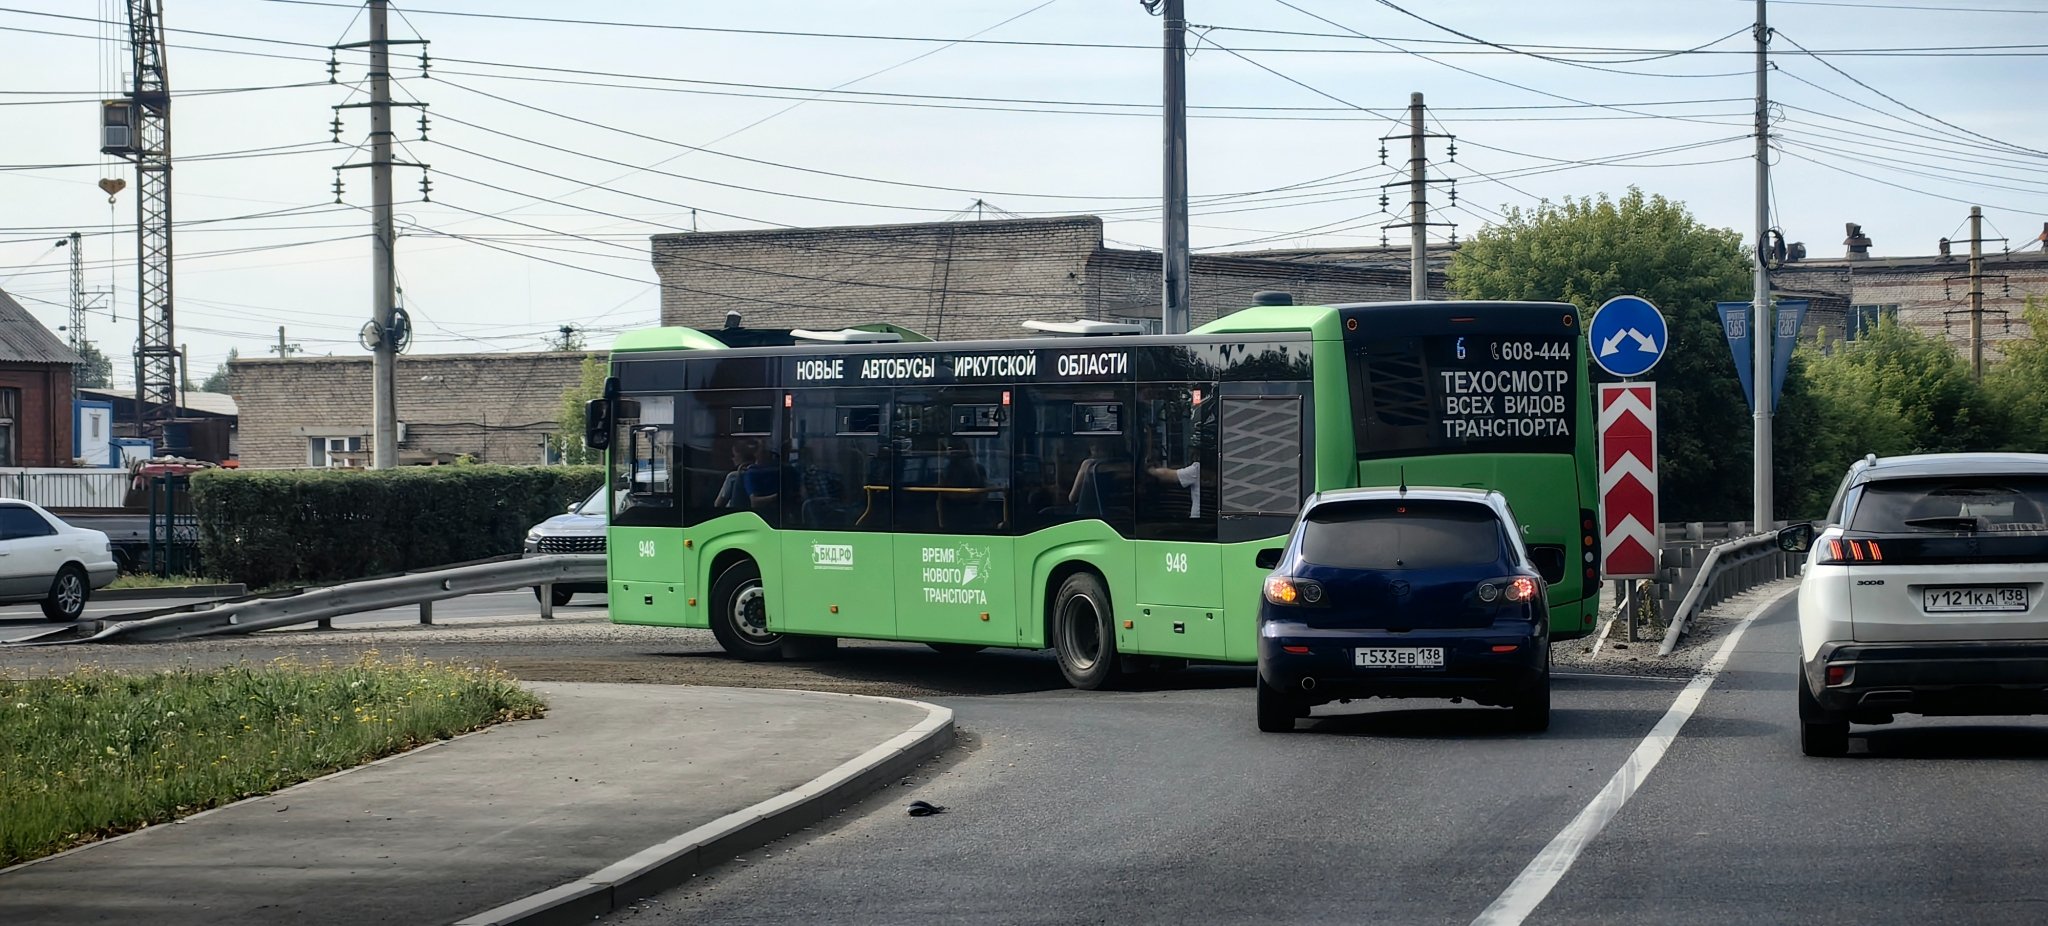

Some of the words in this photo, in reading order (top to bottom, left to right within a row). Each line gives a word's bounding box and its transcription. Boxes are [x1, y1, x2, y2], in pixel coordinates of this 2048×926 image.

[1456, 337, 1466, 360] 6
[1502, 342, 1571, 360] 608-444
[797, 359, 844, 380] НОВЫЕ
[861, 357, 935, 379] АВТОБУСЫ
[954, 350, 1036, 377] ИРКУТСКОЙ
[1058, 352, 1127, 376] ОБЛАСТИ
[1441, 370, 1569, 394] ТЕХОСМОТР
[1446, 396, 1495, 415] ВСЕХ
[1504, 395, 1565, 417] ВИДОВ
[1442, 418, 1570, 438] ТРАНСПОРТА
[638, 540, 655, 558] 948
[820, 547, 852, 563] БКД.РФ
[922, 547, 955, 563] ВРЕМЯ
[1166, 552, 1188, 573] 948
[922, 567, 961, 583] НОВОГО
[923, 587, 987, 605] ТРАНСПОРТА
[1930, 590, 1995, 606] У121КА
[1999, 589, 2024, 601] 138
[1360, 649, 1416, 664] Т533ЕВ
[1419, 648, 1441, 660] 138
